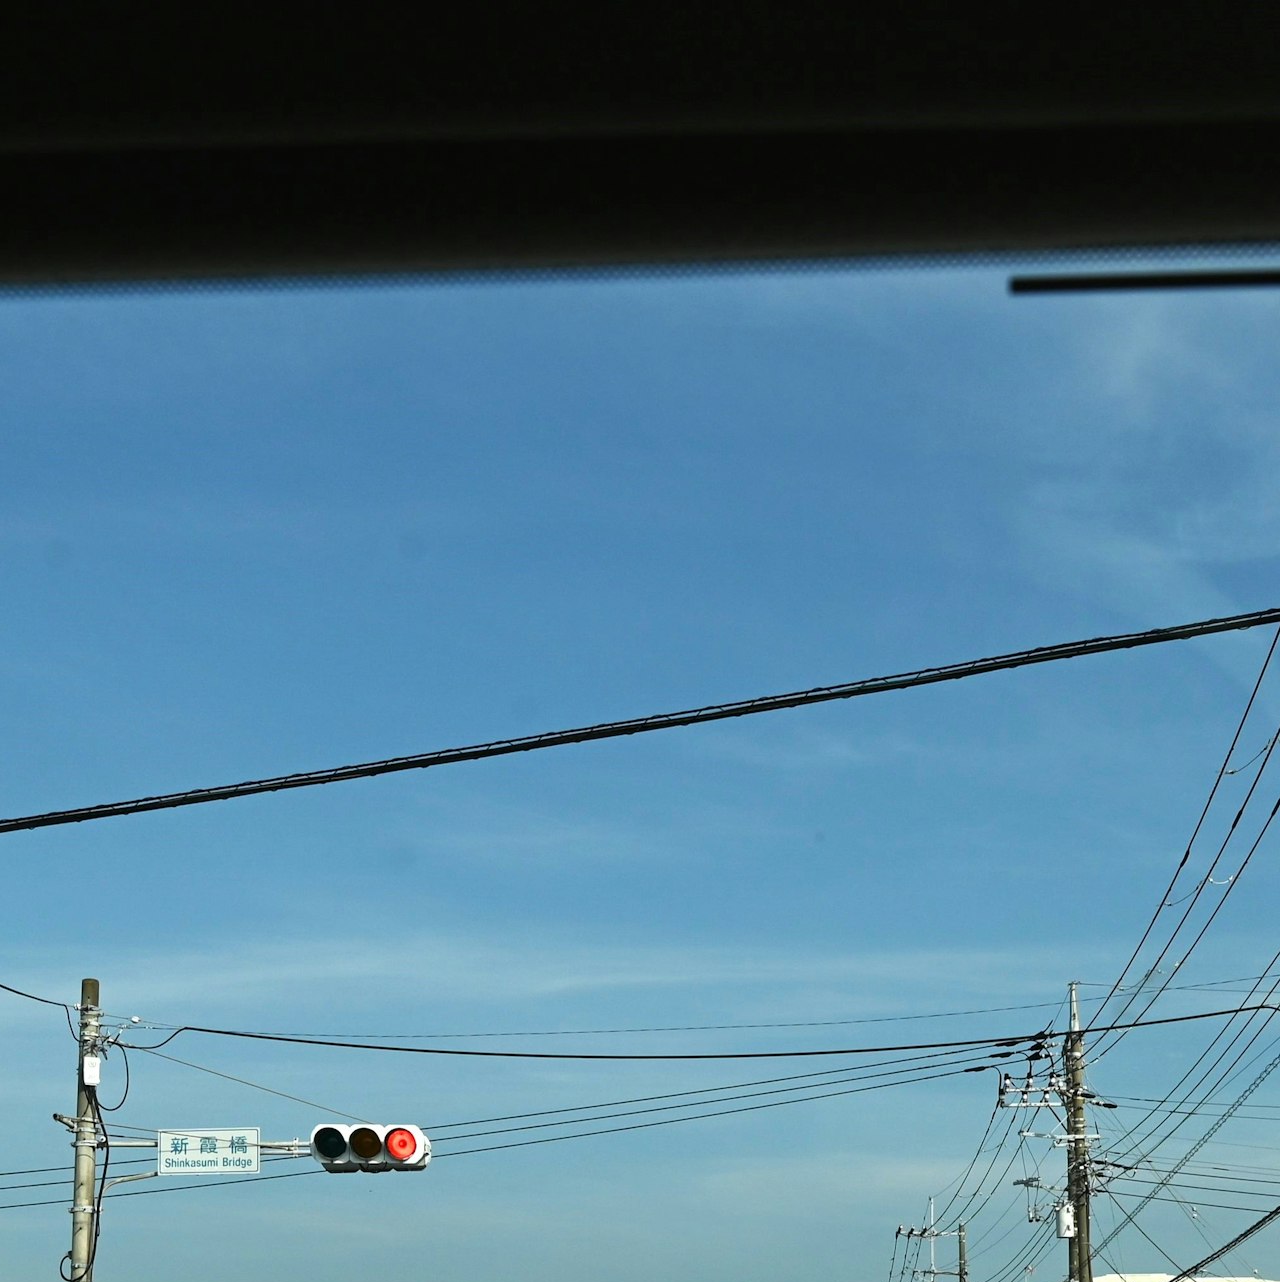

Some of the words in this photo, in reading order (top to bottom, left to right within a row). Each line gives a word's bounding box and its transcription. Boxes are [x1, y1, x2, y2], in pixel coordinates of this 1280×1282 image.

[170, 1136, 248, 1155] 新霞橋
[165, 1158, 219, 1168] Shinkasumi
[222, 1157, 253, 1168] Bridge
